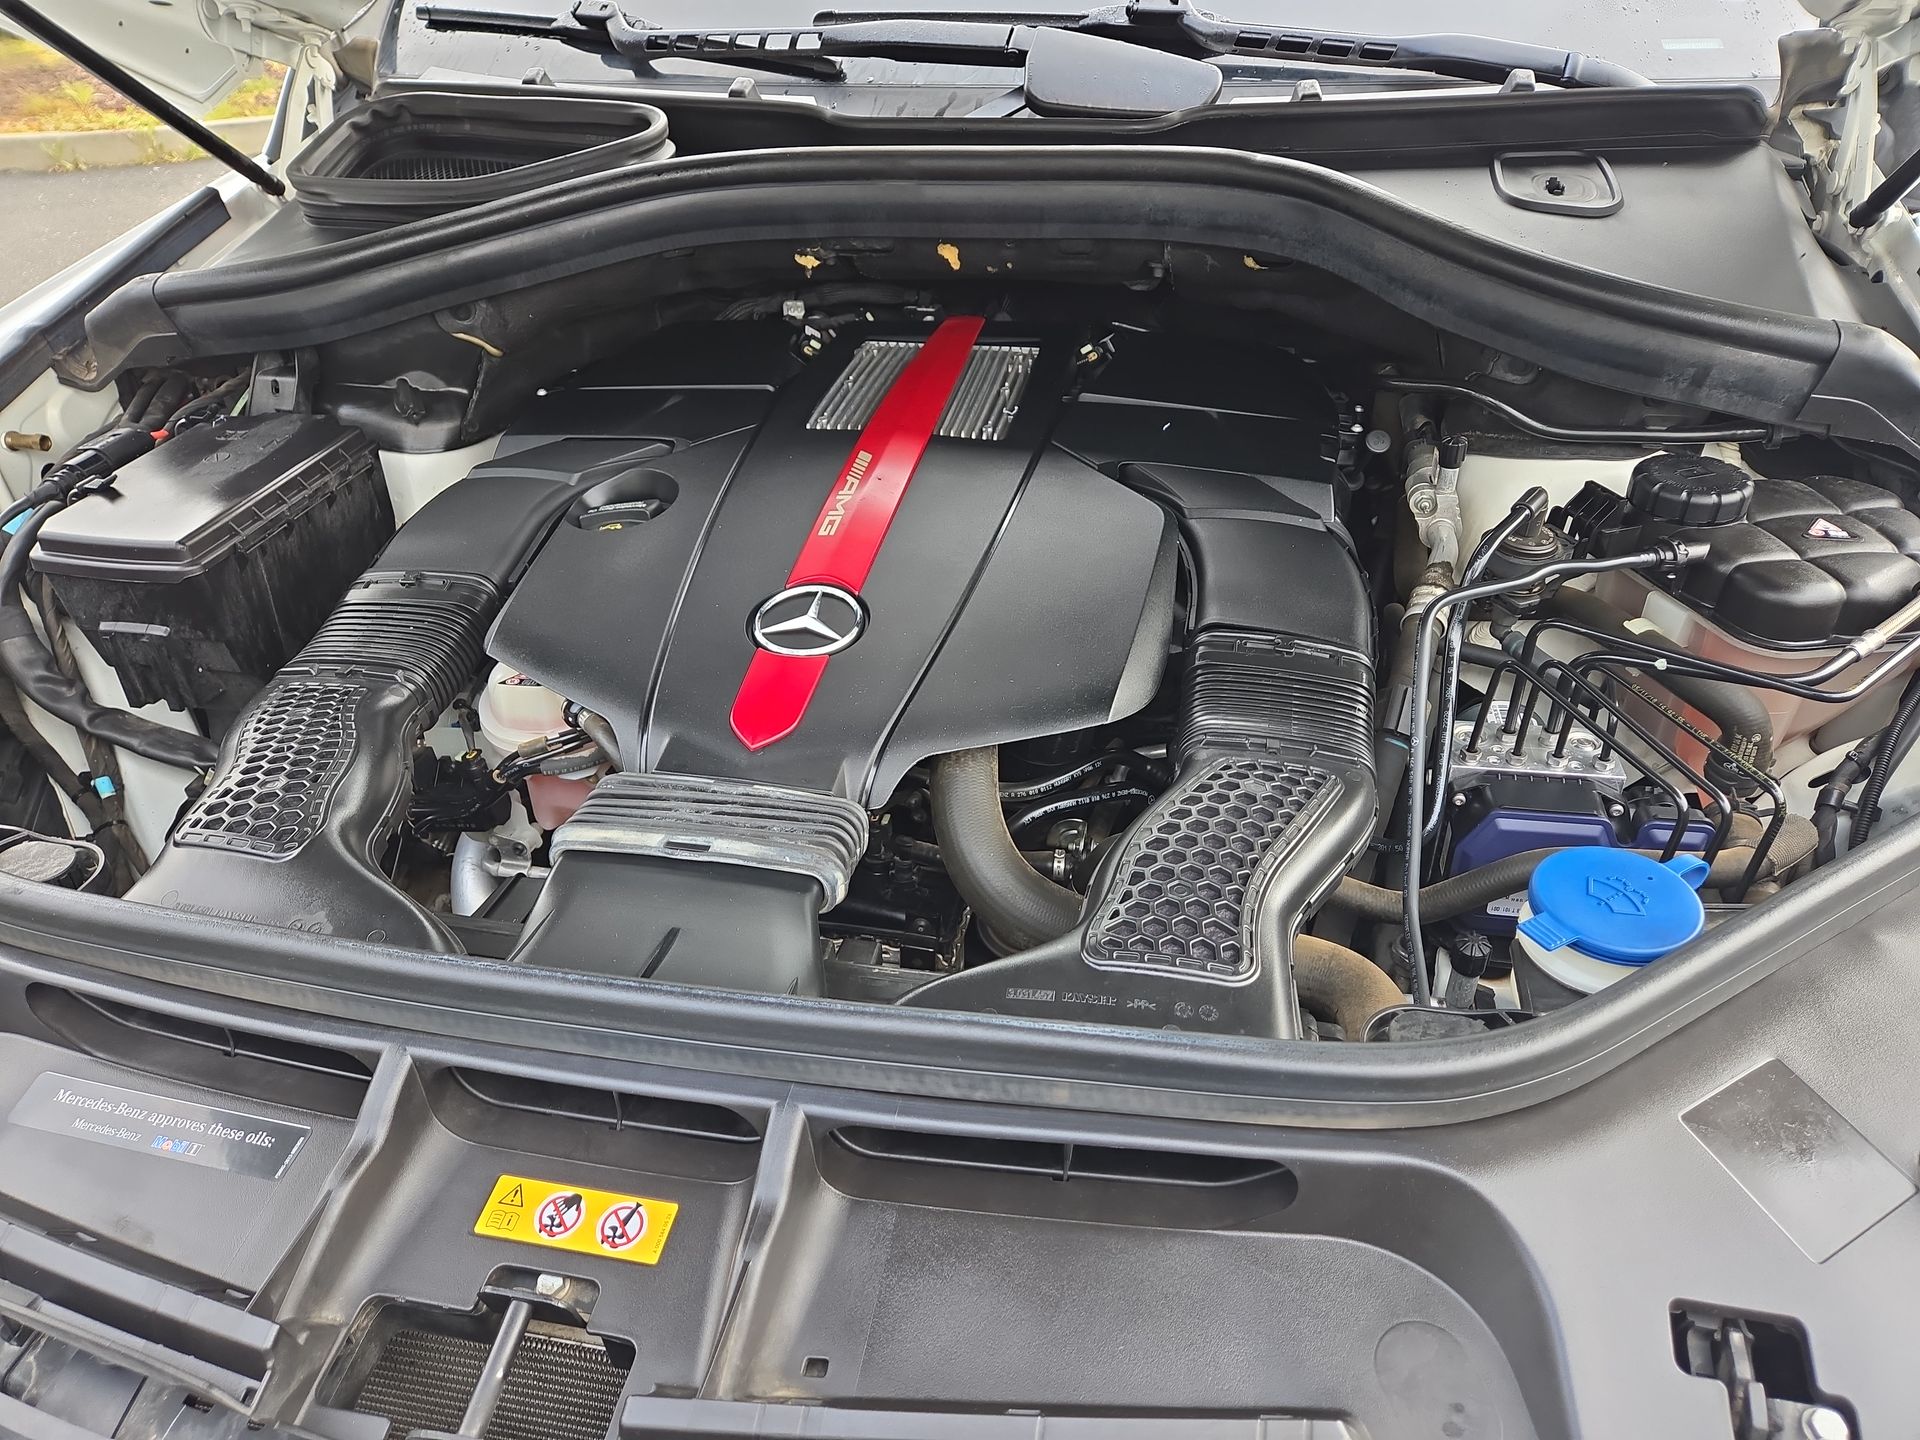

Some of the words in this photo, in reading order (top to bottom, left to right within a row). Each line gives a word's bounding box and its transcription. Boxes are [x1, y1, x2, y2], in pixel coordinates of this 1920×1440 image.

[818, 474, 862, 536] AMG
[1028, 788, 1038, 796] 010
[1040, 785, 1053, 794] 0112
[53, 1088, 148, 1121] Mercedes-Benz
[147, 1110, 207, 1134] approves
[207, 1122, 245, 1142] these
[245, 1130, 276, 1149] oils:
[71, 1117, 142, 1142] Mercedes-Benz
[150, 1135, 188, 1154] Mobil
